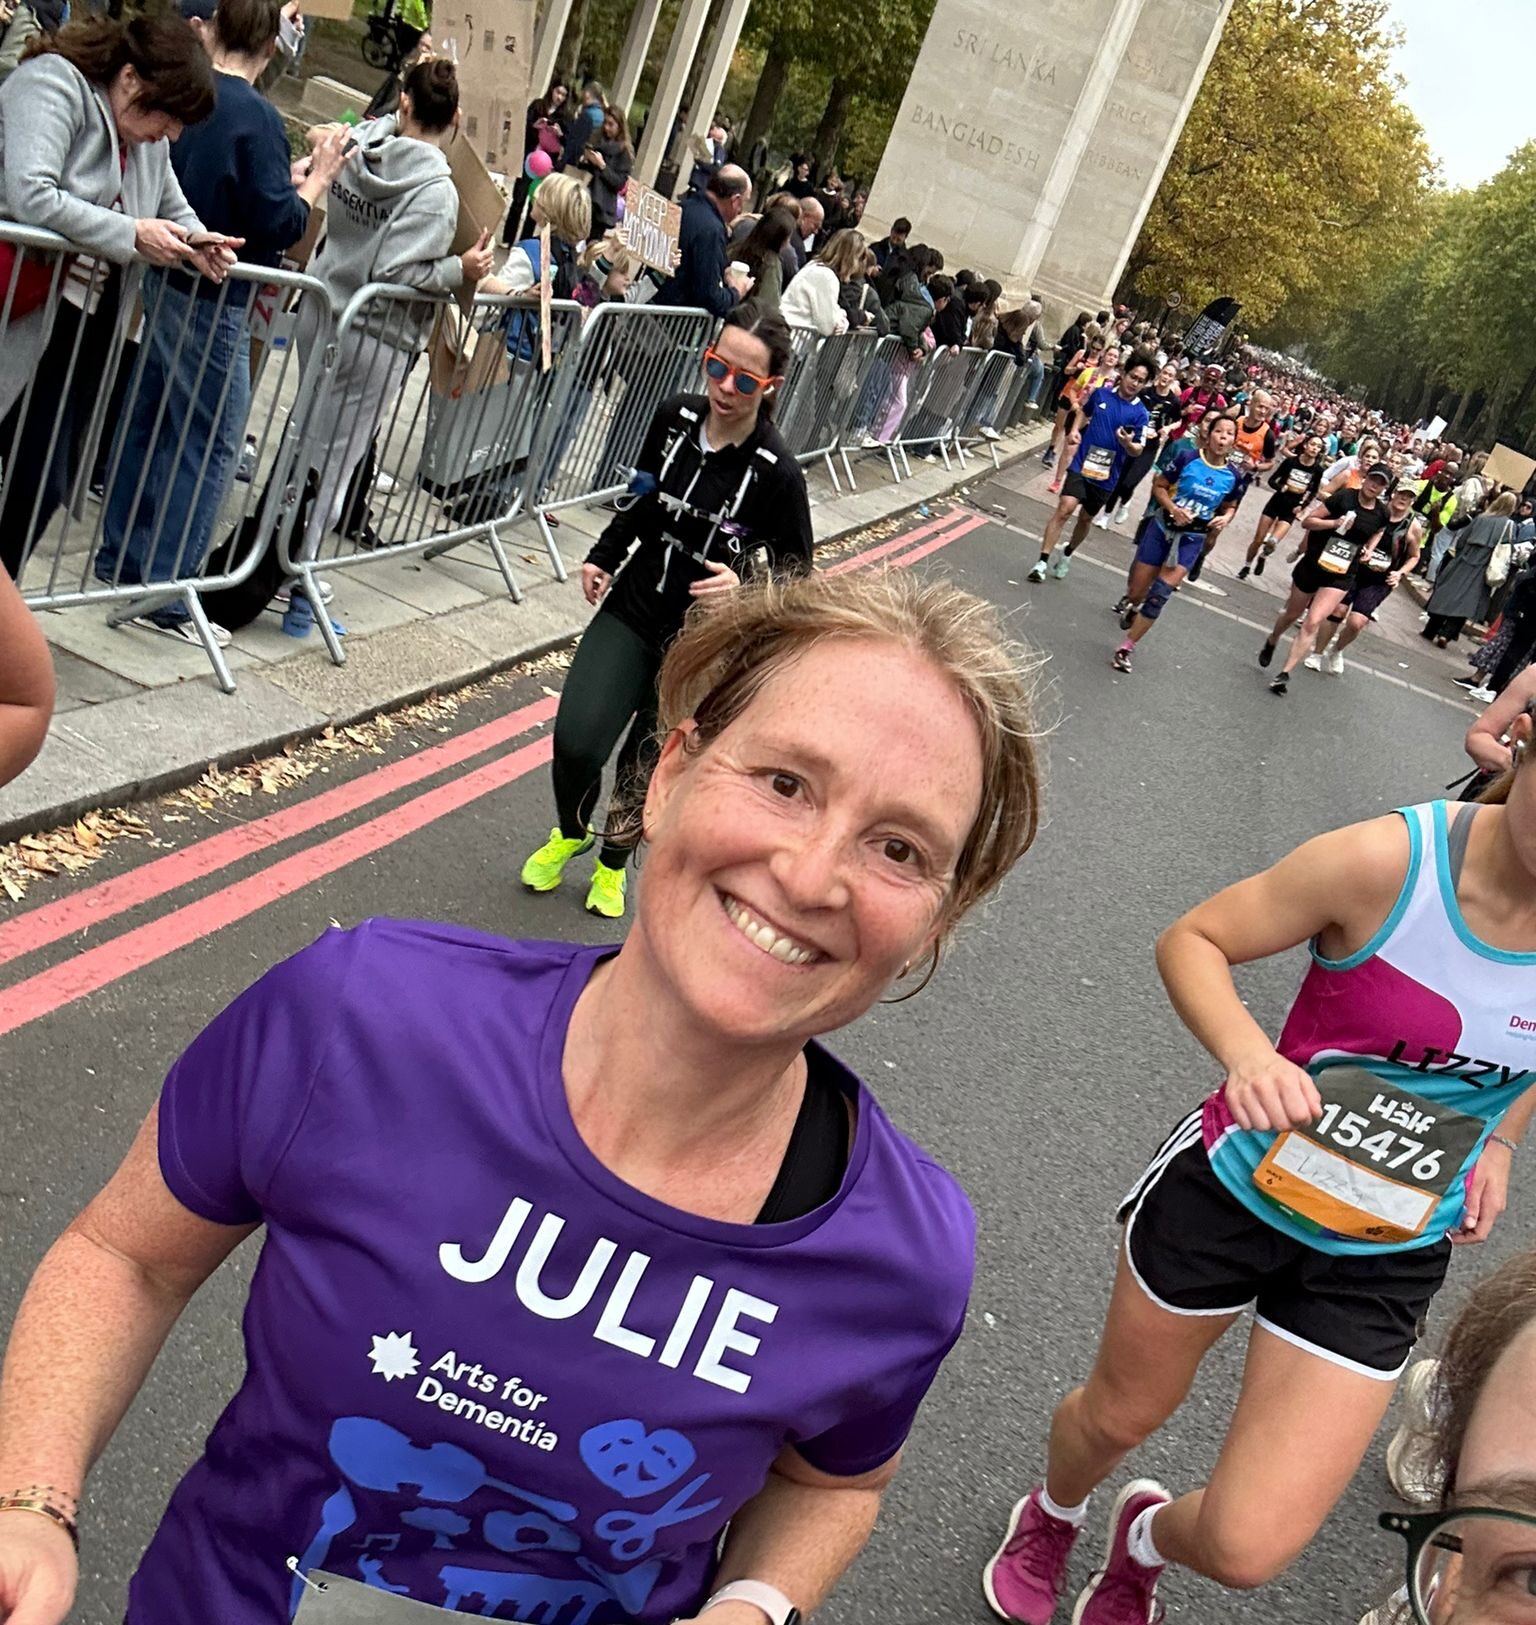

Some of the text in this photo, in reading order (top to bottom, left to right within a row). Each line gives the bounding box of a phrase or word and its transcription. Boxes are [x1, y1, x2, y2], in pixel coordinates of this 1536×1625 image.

[953, 28, 1056, 86] SRI LANKA
[910, 104, 1041, 171] BANGLADESH
[331, 181, 394, 222] ESSENTIA
[638, 185, 668, 227] KEEP
[1329, 544, 1351, 559] 3473
[1387, 1040, 1529, 1089] LIZZY
[1316, 1103, 1447, 1181] 15476
[1368, 1093, 1436, 1135] Half
[439, 1197, 779, 1394] JULIE
[430, 1350, 548, 1411] Arts for
[416, 1376, 558, 1452] Dementia
